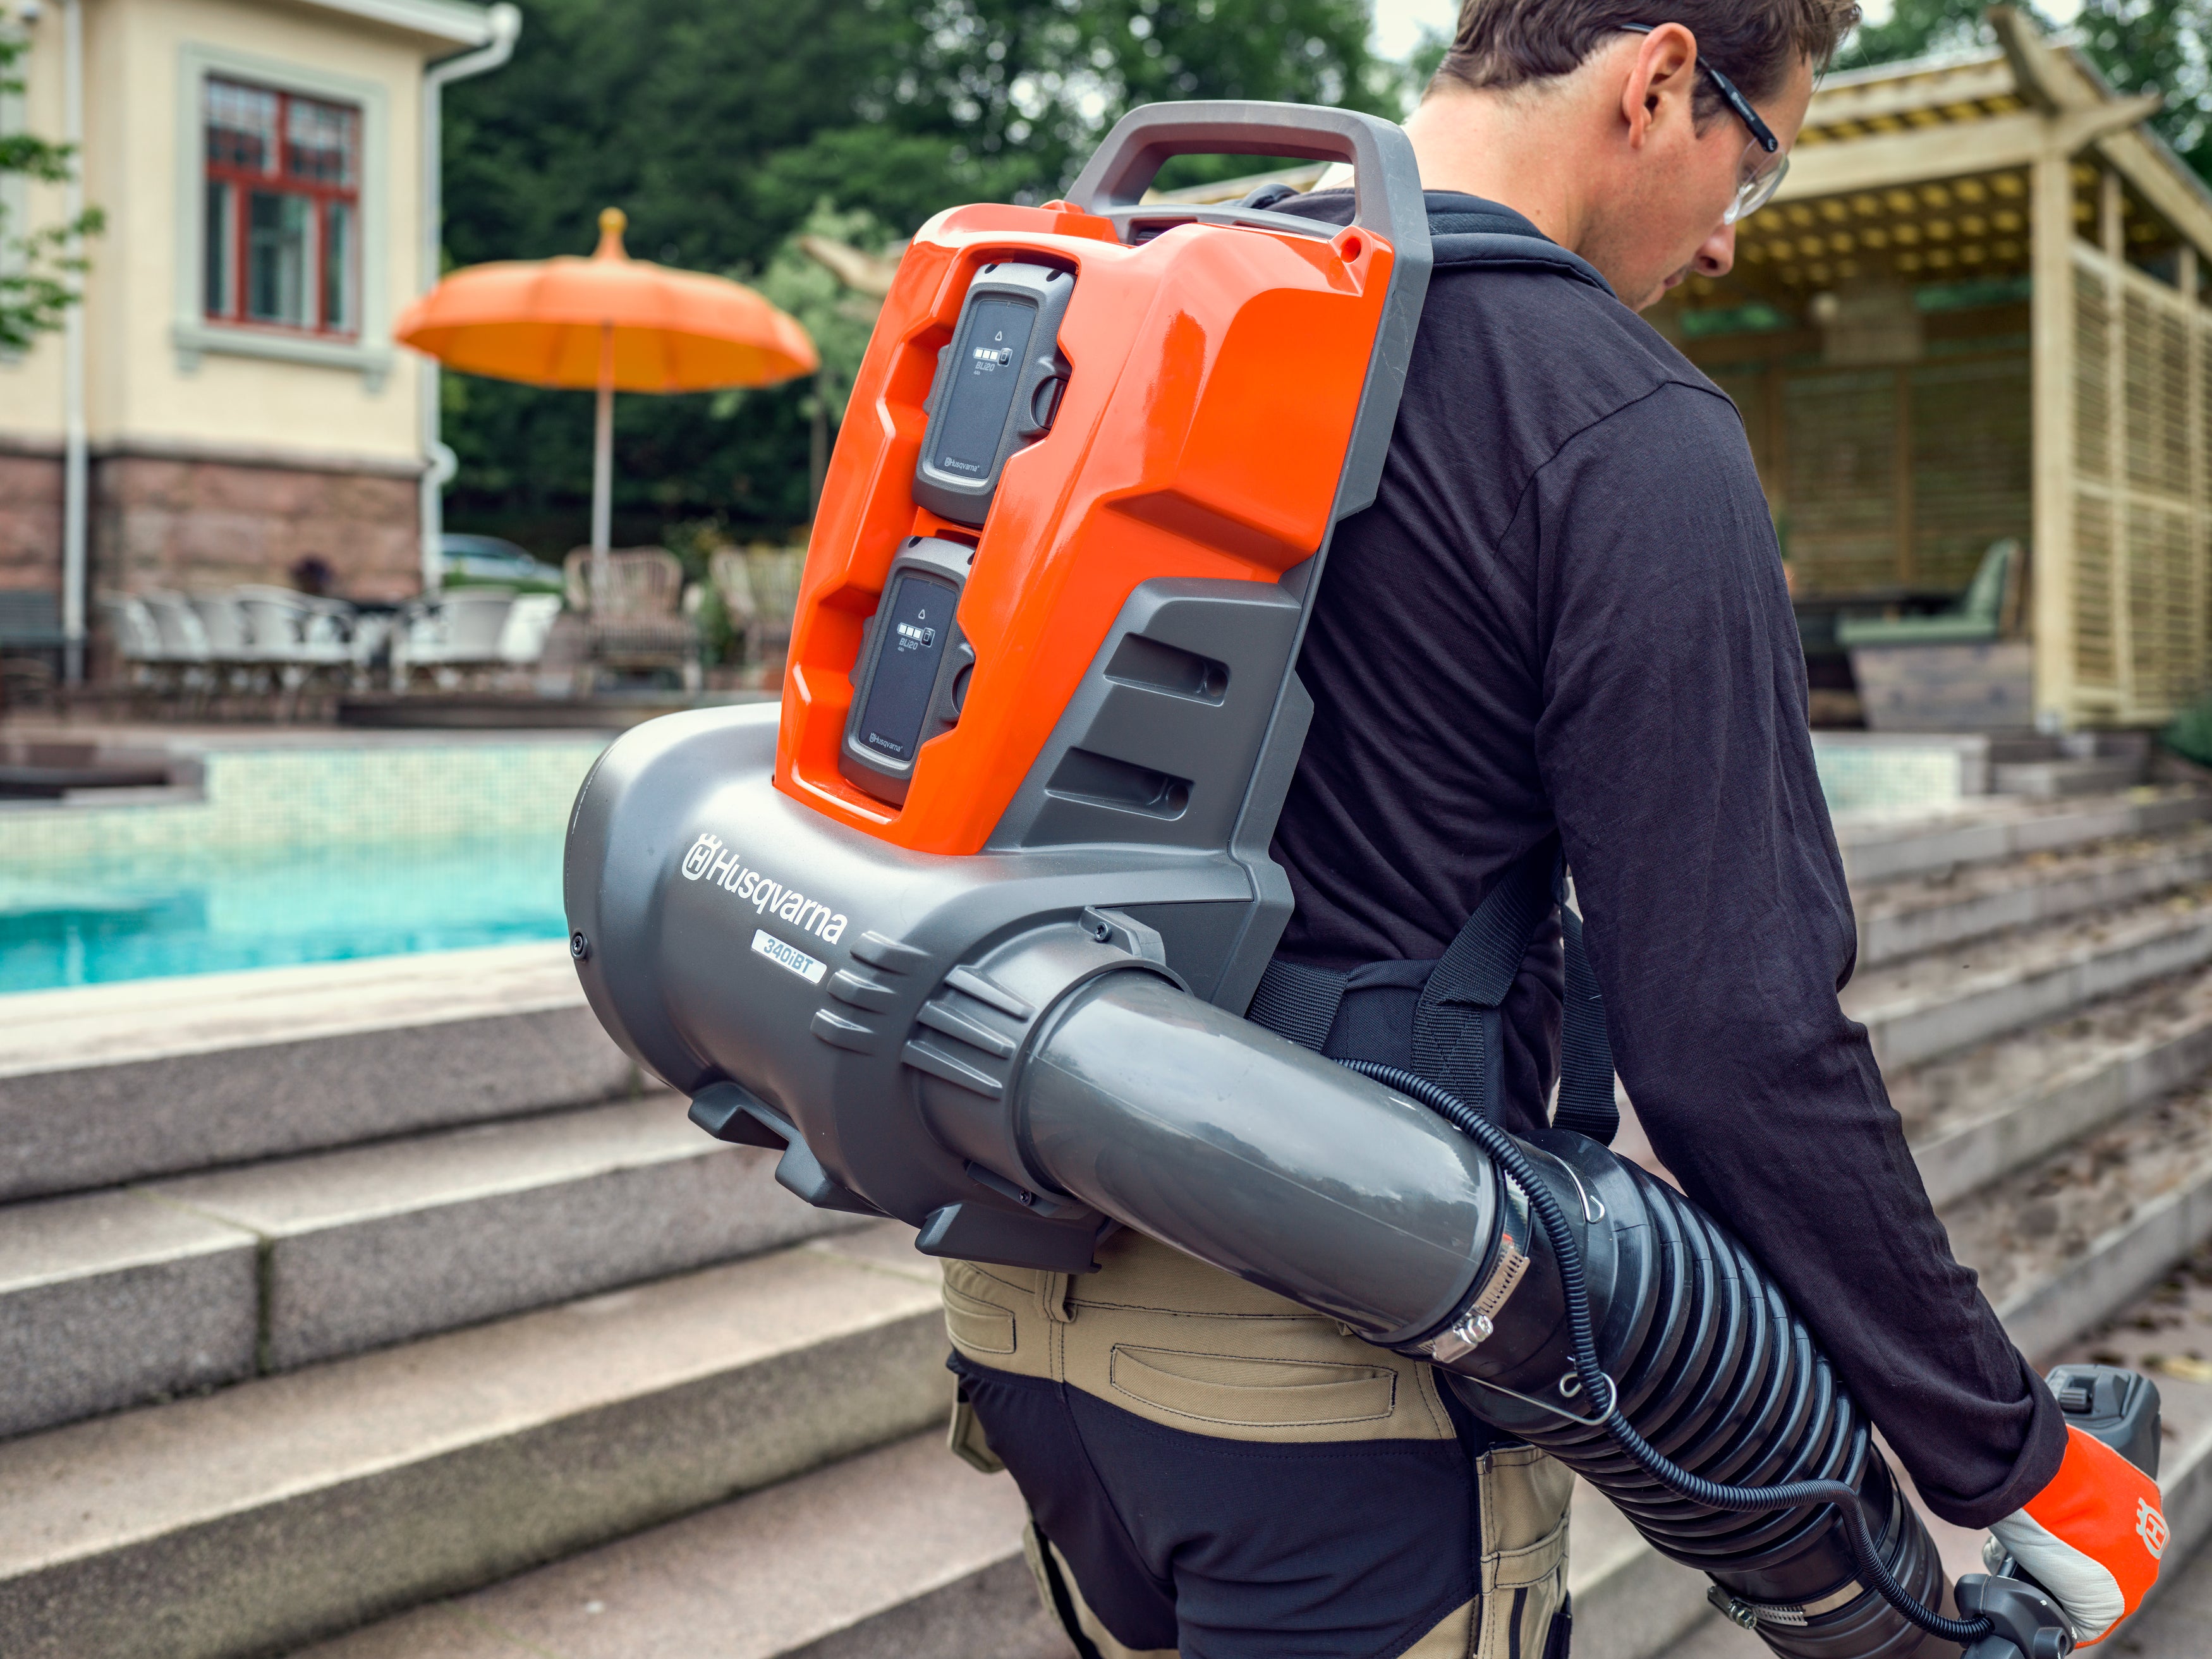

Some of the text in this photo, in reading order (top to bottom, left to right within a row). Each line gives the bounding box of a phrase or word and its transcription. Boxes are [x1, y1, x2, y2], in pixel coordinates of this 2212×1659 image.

[975, 361, 995, 372] BLi20
[949, 459, 978, 472] Husqvarna
[899, 637, 918, 650] BLi20
[874, 735, 901, 752] Husqvarna
[705, 848, 848, 945] Husqvarna
[763, 938, 814, 974] 340iBT
